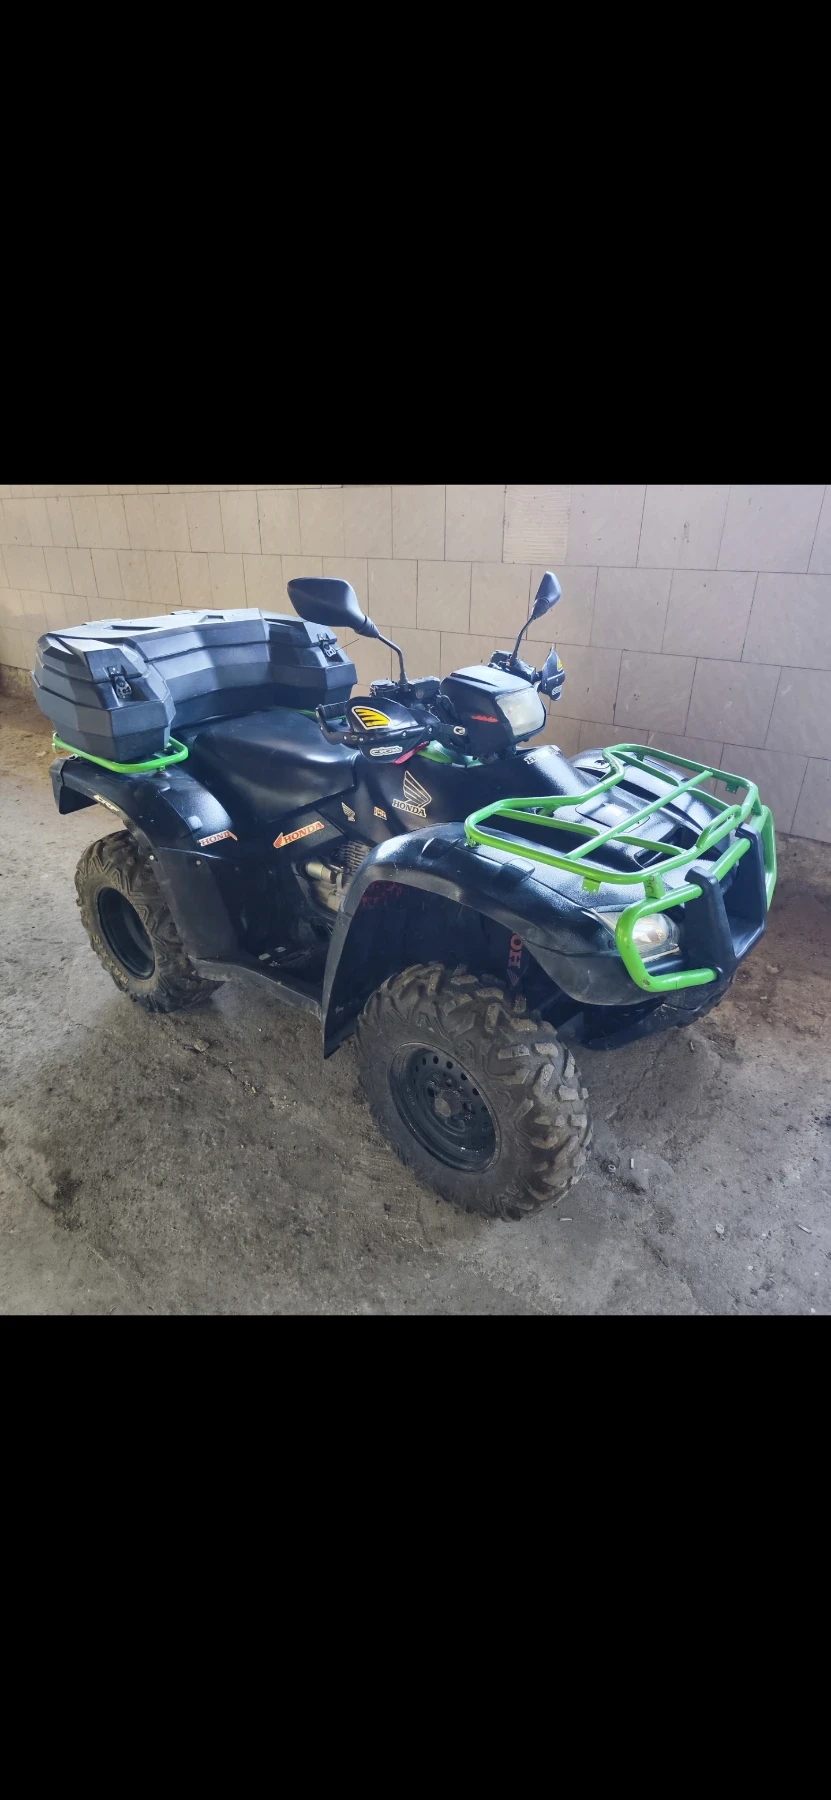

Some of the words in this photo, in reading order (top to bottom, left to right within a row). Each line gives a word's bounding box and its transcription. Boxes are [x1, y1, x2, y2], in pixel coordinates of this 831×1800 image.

[392, 799, 426, 817] HONDA
[201, 831, 231, 846] HOND
[283, 822, 322, 844] HONDA
[508, 934, 523, 969] HO
